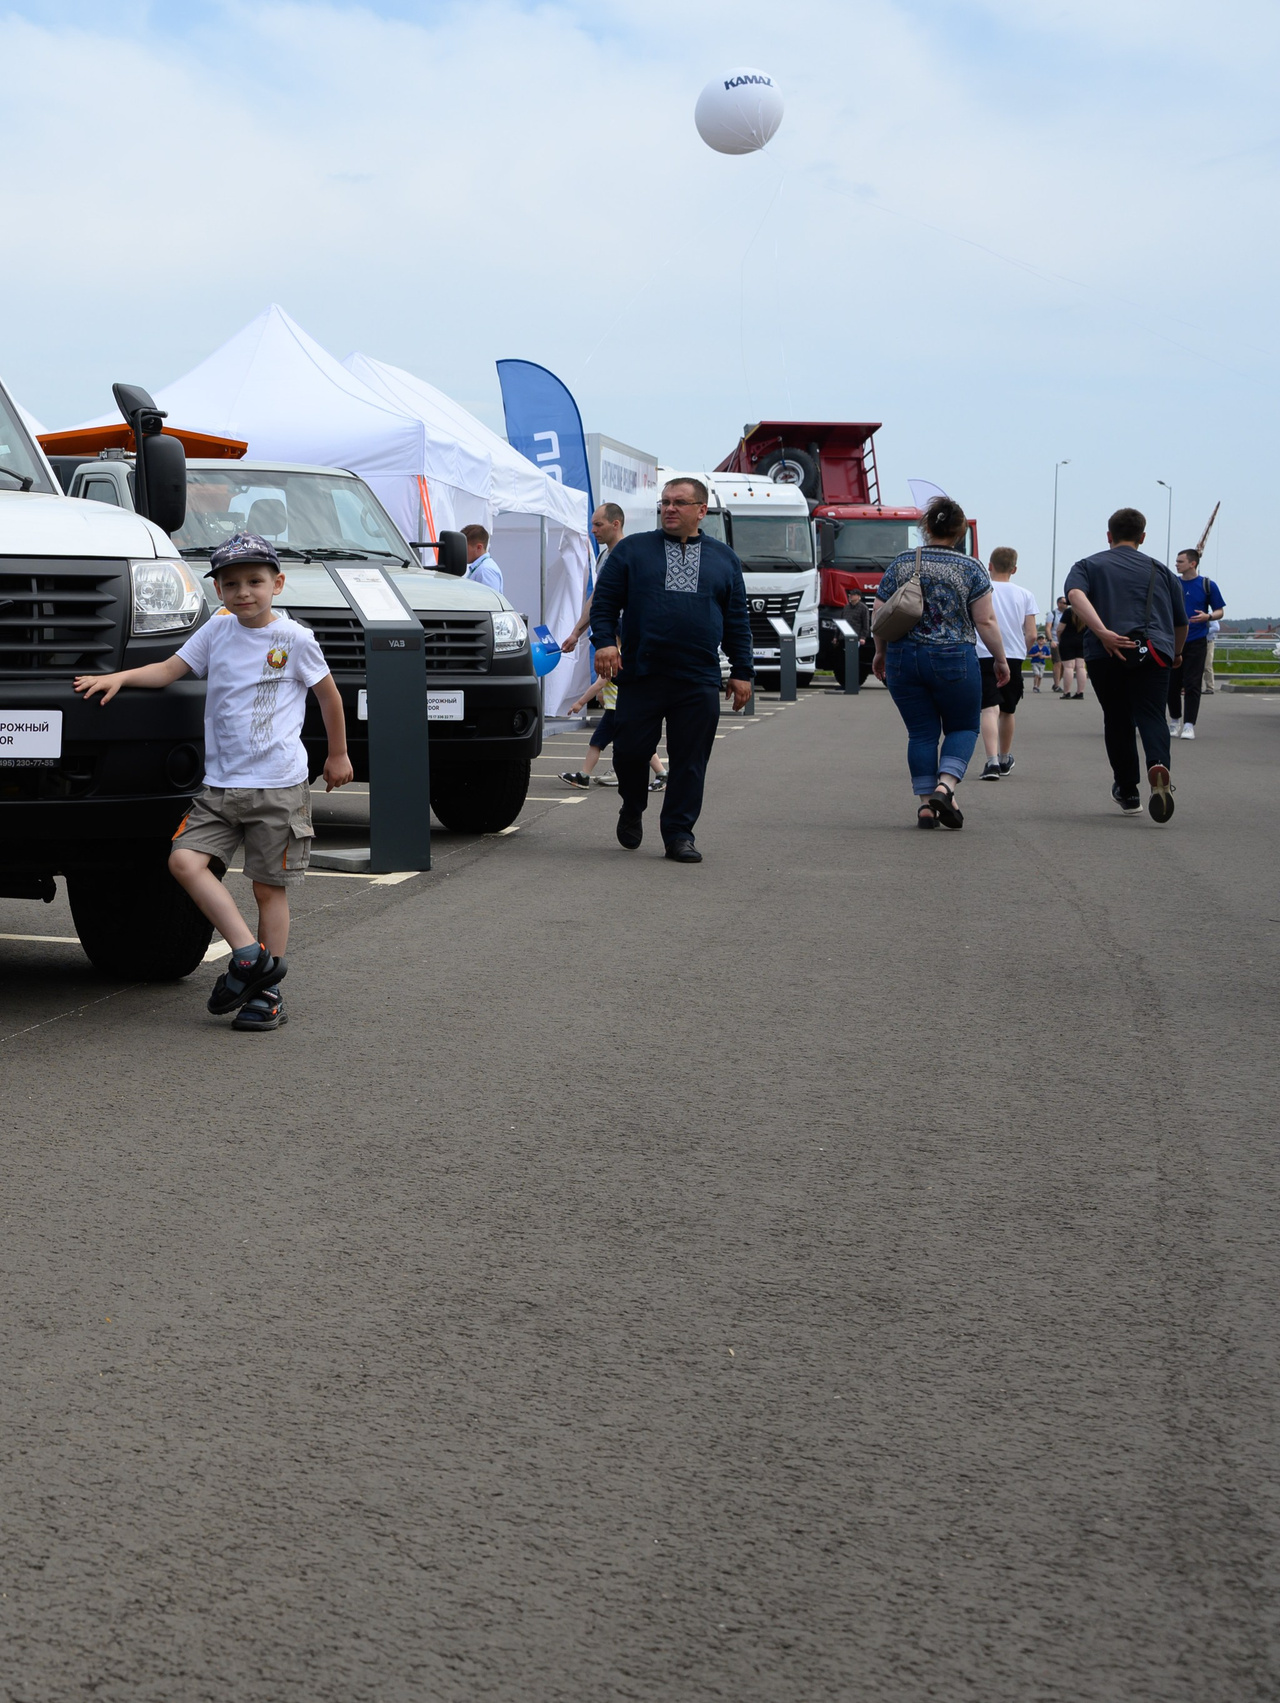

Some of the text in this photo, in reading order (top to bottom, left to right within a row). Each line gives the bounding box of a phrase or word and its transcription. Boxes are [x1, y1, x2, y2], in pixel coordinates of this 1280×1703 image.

[724, 75, 774, 91] KAMAZ
[388, 640, 406, 648] УАЗ
[16, 759, 54, 767] 230-77-55
